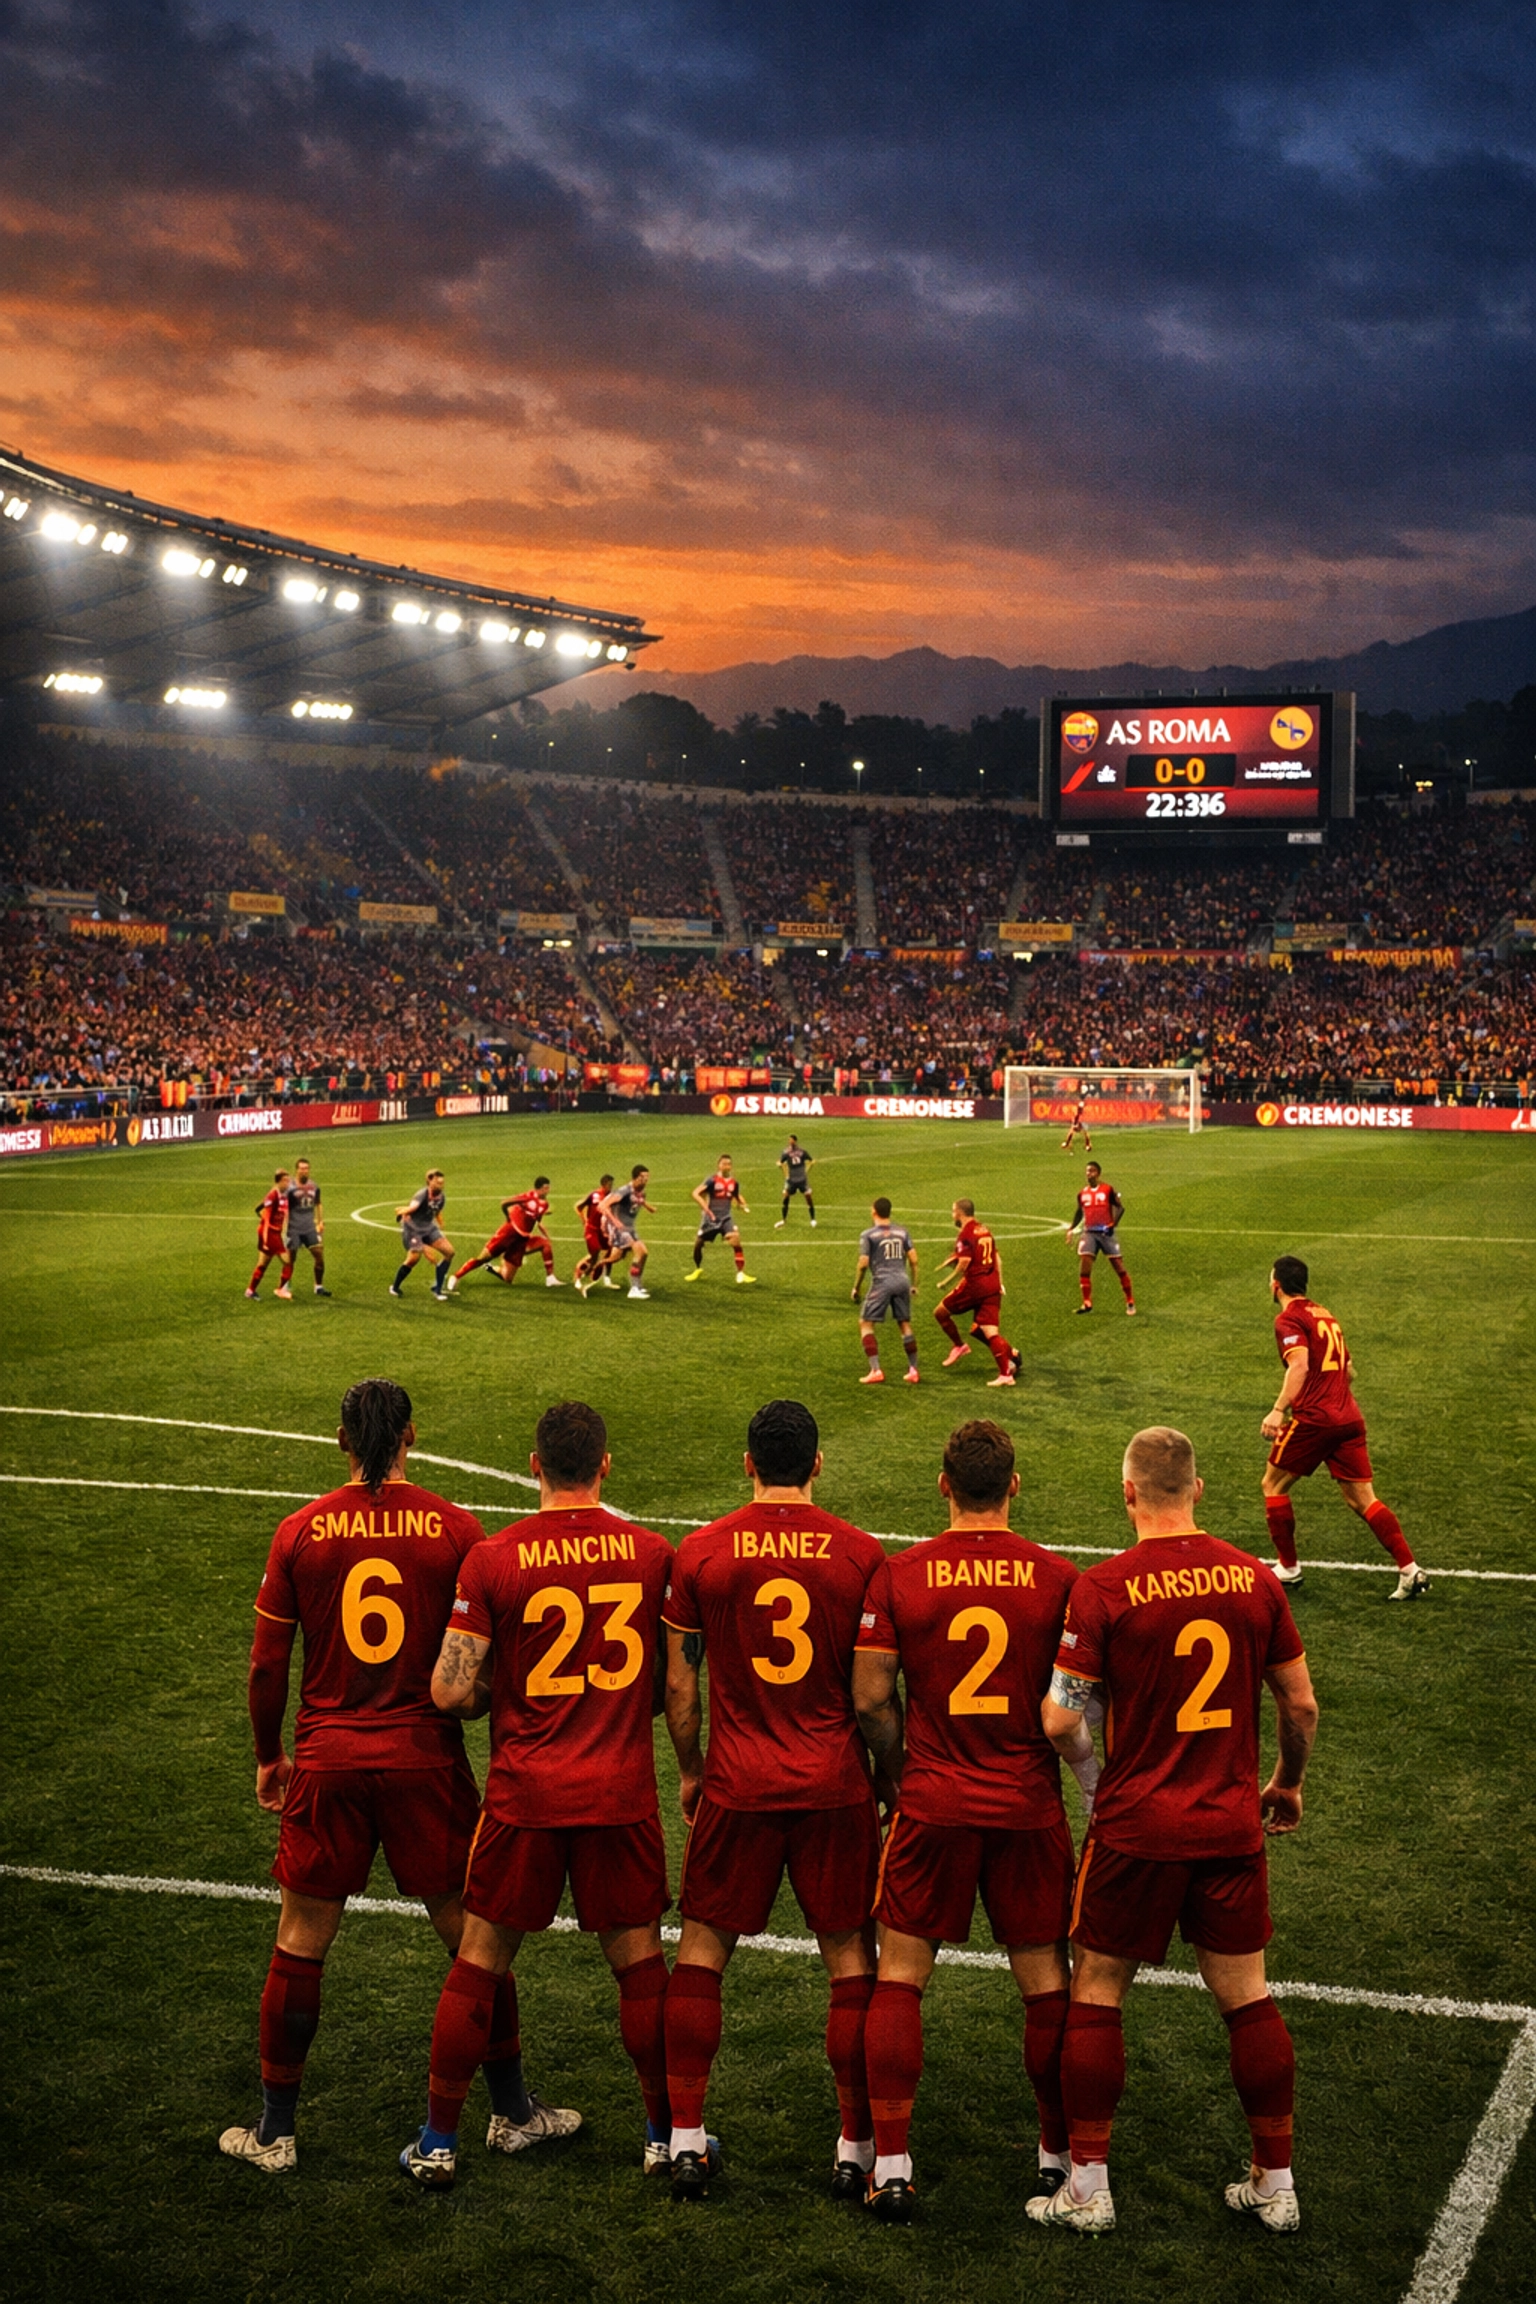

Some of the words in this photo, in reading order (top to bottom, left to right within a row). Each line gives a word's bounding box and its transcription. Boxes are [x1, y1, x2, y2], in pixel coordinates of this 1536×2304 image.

[1105, 719, 1143, 746] AS
[1148, 718, 1231, 744] ROMA
[1155, 757, 1206, 784] 0-0
[733, 1096, 760, 1114] AS
[763, 1096, 825, 1116] ROMA
[863, 1097, 976, 1118] CREMONESE
[1283, 1105, 1414, 1128] CREMONESE
[311, 1509, 443, 1542] SMALLING
[517, 1534, 636, 1570] MANCINI
[733, 1531, 833, 1559] IBANEZ
[1125, 1565, 1255, 1607] KARSDORP
[341, 1557, 406, 1664] 6
[523, 1582, 645, 1697] 23
[751, 1577, 814, 1685] 3
[947, 1606, 1009, 1715] 2
[1174, 1618, 1232, 1732] 2
